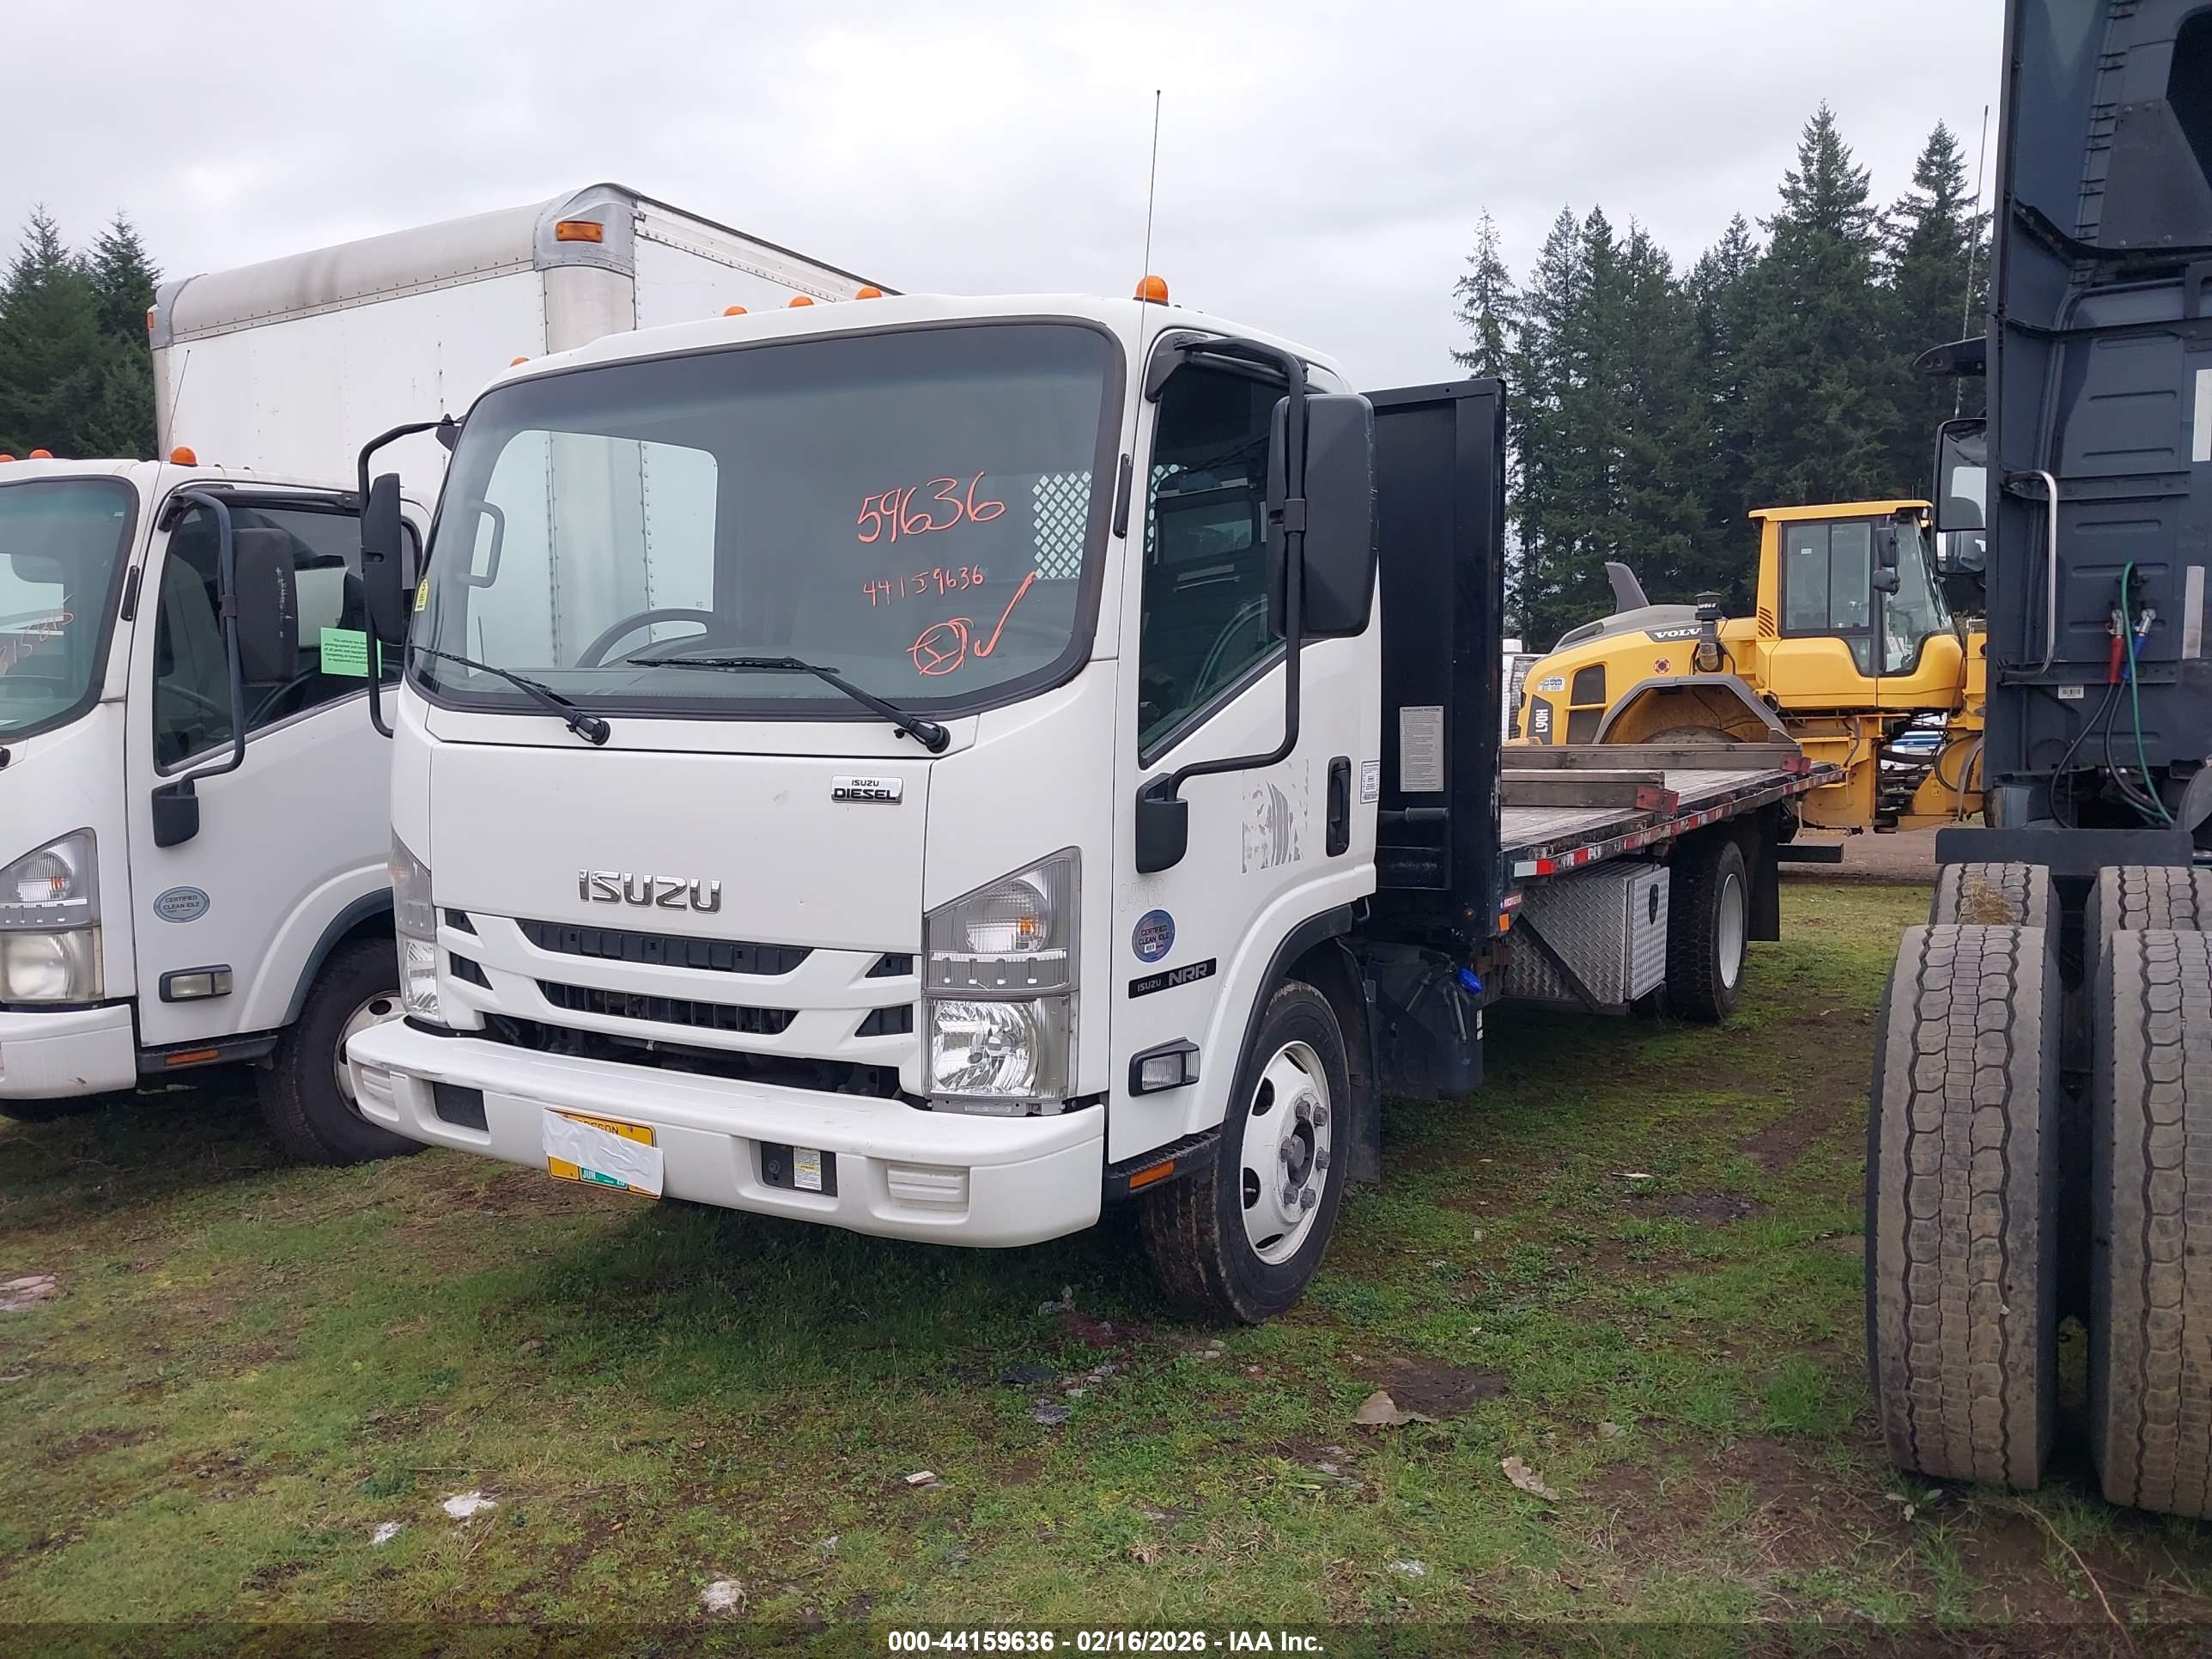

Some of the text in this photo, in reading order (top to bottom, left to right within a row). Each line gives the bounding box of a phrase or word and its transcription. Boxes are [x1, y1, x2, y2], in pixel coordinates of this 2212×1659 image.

[857, 471, 1006, 543] 59636
[862, 563, 984, 607] 44159636
[1654, 628, 1702, 638] VOLV
[1535, 708, 1548, 732] L90H
[834, 787, 896, 800] DIESEL
[165, 895, 198, 903] CERTIFIED
[579, 868, 722, 914] ISUZU
[1138, 934, 1157, 945] CLEAN
[1140, 925, 1168, 937] CERTIFIED
[1137, 963, 1207, 992] ISUZU NRR
